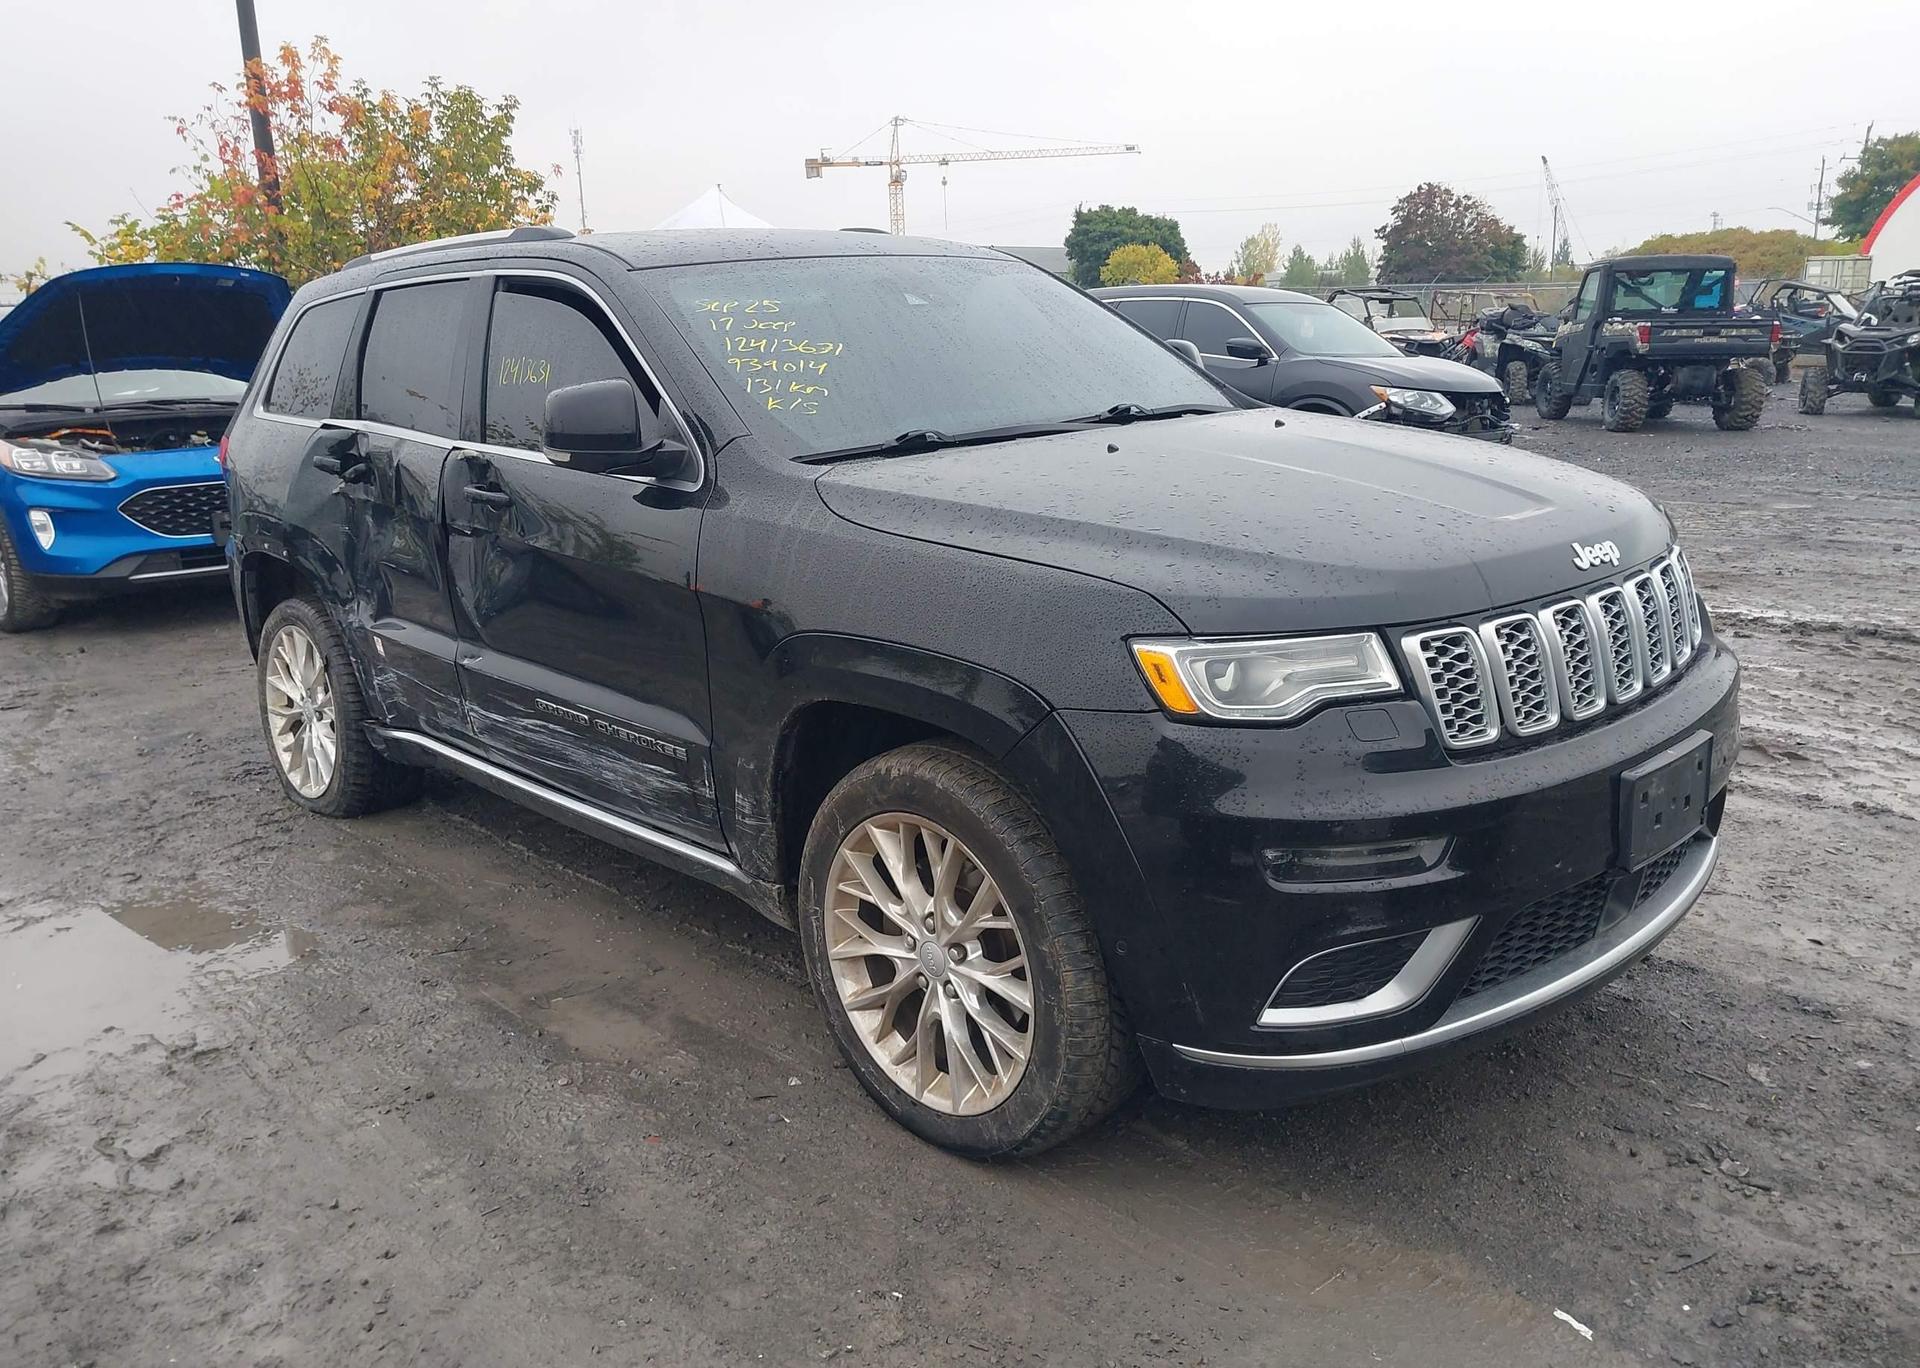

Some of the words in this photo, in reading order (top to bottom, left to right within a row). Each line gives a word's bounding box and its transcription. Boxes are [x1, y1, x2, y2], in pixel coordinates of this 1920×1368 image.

[744, 300, 781, 313] 25
[710, 317, 734, 331] 17
[1571, 540, 1620, 571] Jeep
[593, 719, 688, 761] CHEROKEE
